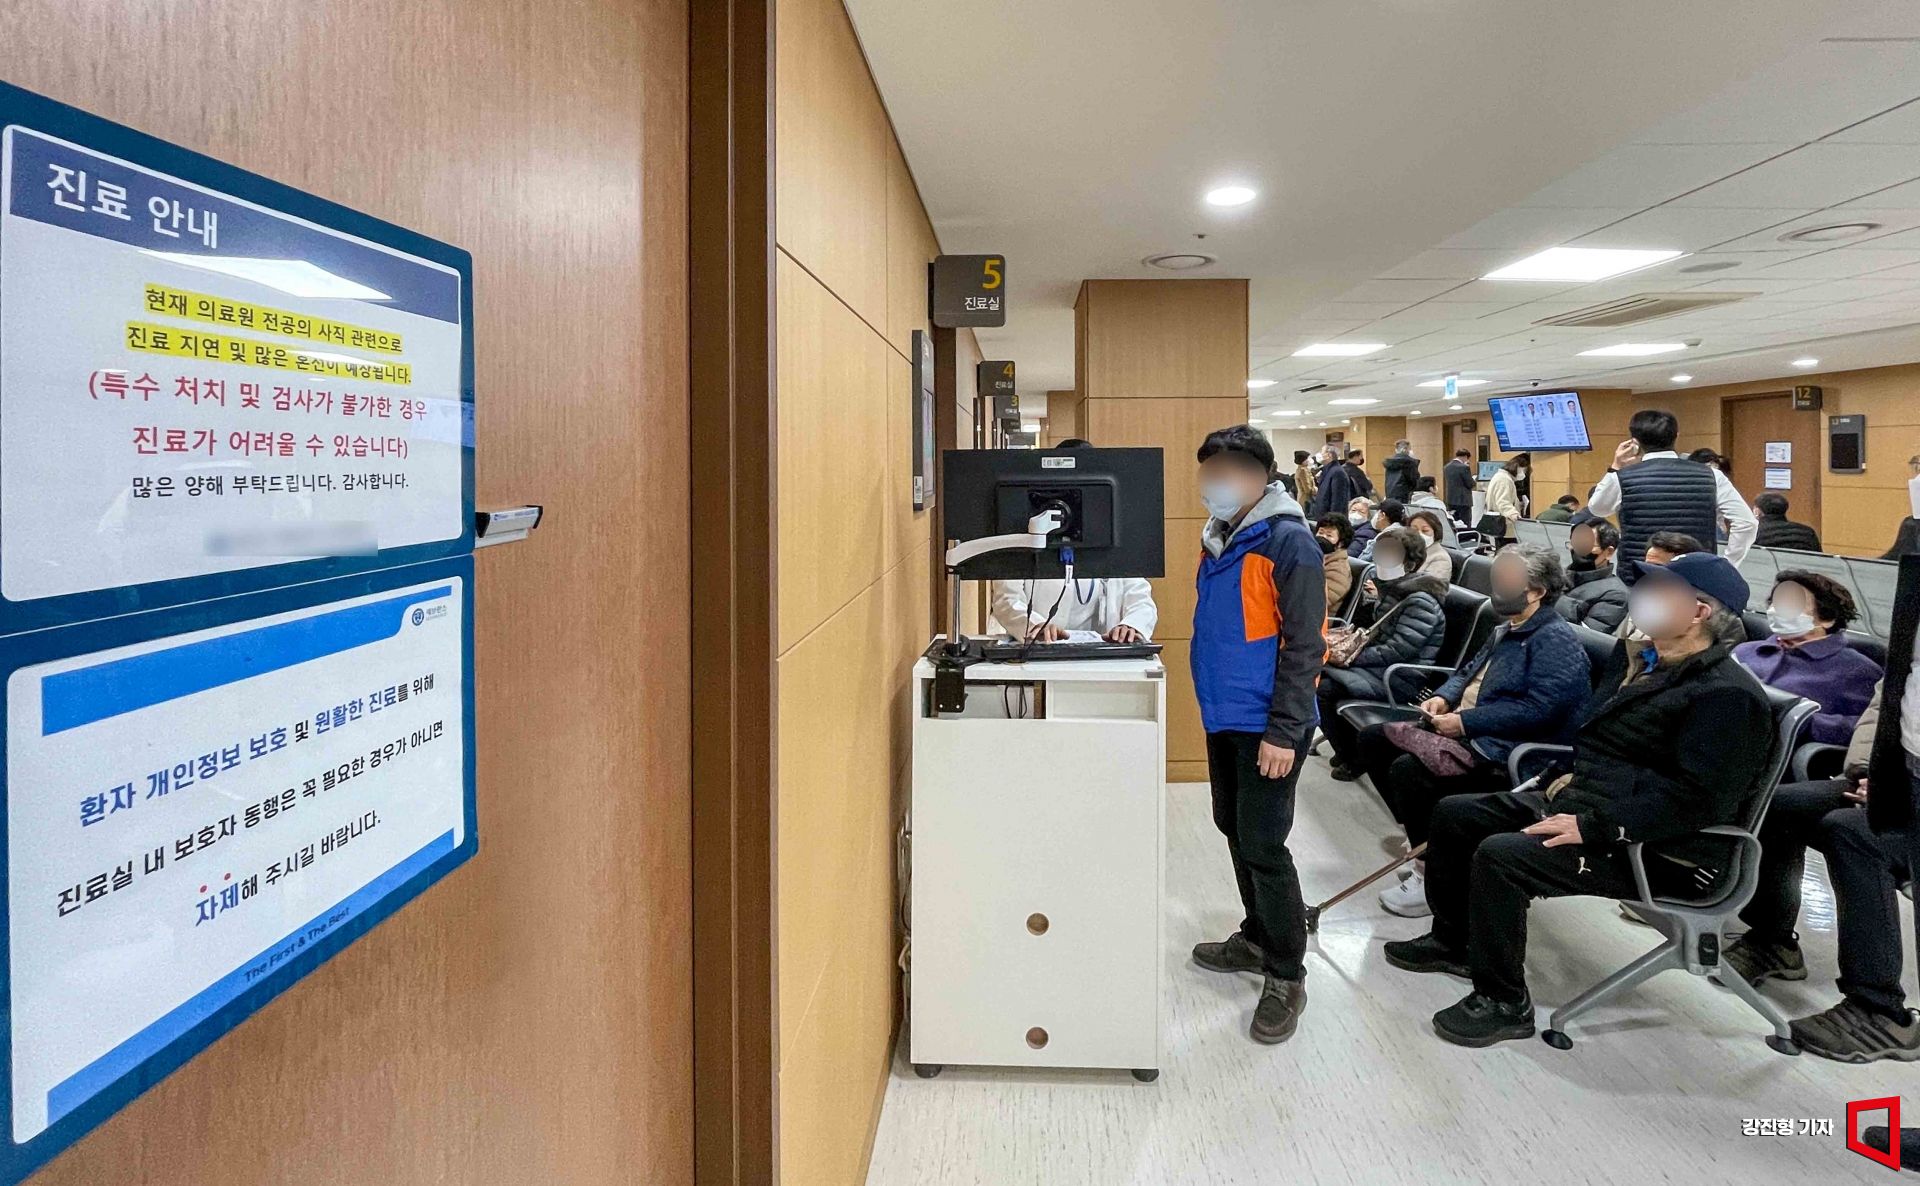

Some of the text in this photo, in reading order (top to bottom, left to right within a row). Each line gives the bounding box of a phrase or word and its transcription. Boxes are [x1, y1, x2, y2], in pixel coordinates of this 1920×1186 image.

[47, 163, 218, 249] 진료 안내
[982, 259, 1001, 289] 5
[146, 288, 403, 352] 현재 의료원 전공의 사직 관련으로
[964, 296, 1000, 311] 진료실
[128, 326, 170, 350] 진료
[180, 335, 220, 359] 지연
[230, 342, 246, 363] 및
[255, 346, 288, 368] 많은
[1003, 363, 1014, 378] 4
[1796, 387, 1811, 398] 12
[89, 371, 427, 421] (특수 처치 및 검사가 불가한 경우
[133, 426, 408, 459] 진료가 어려울 수 있습니다)
[132, 473, 409, 499] 많은 양해 부탁드립니다. 감사합니다.
[79, 673, 434, 828] 환자 개인정보 보호 및 원활한 진료를 위해
[57, 720, 443, 918] 진료실 내 보호자 동행은 꼭 필요한 경우가 아니면
[195, 810, 381, 927] 자제해 주시길 바랍니다.
[244, 963, 267, 982] The
[269, 943, 295, 967] First
[308, 923, 328, 940] The
[329, 907, 350, 927] Best
